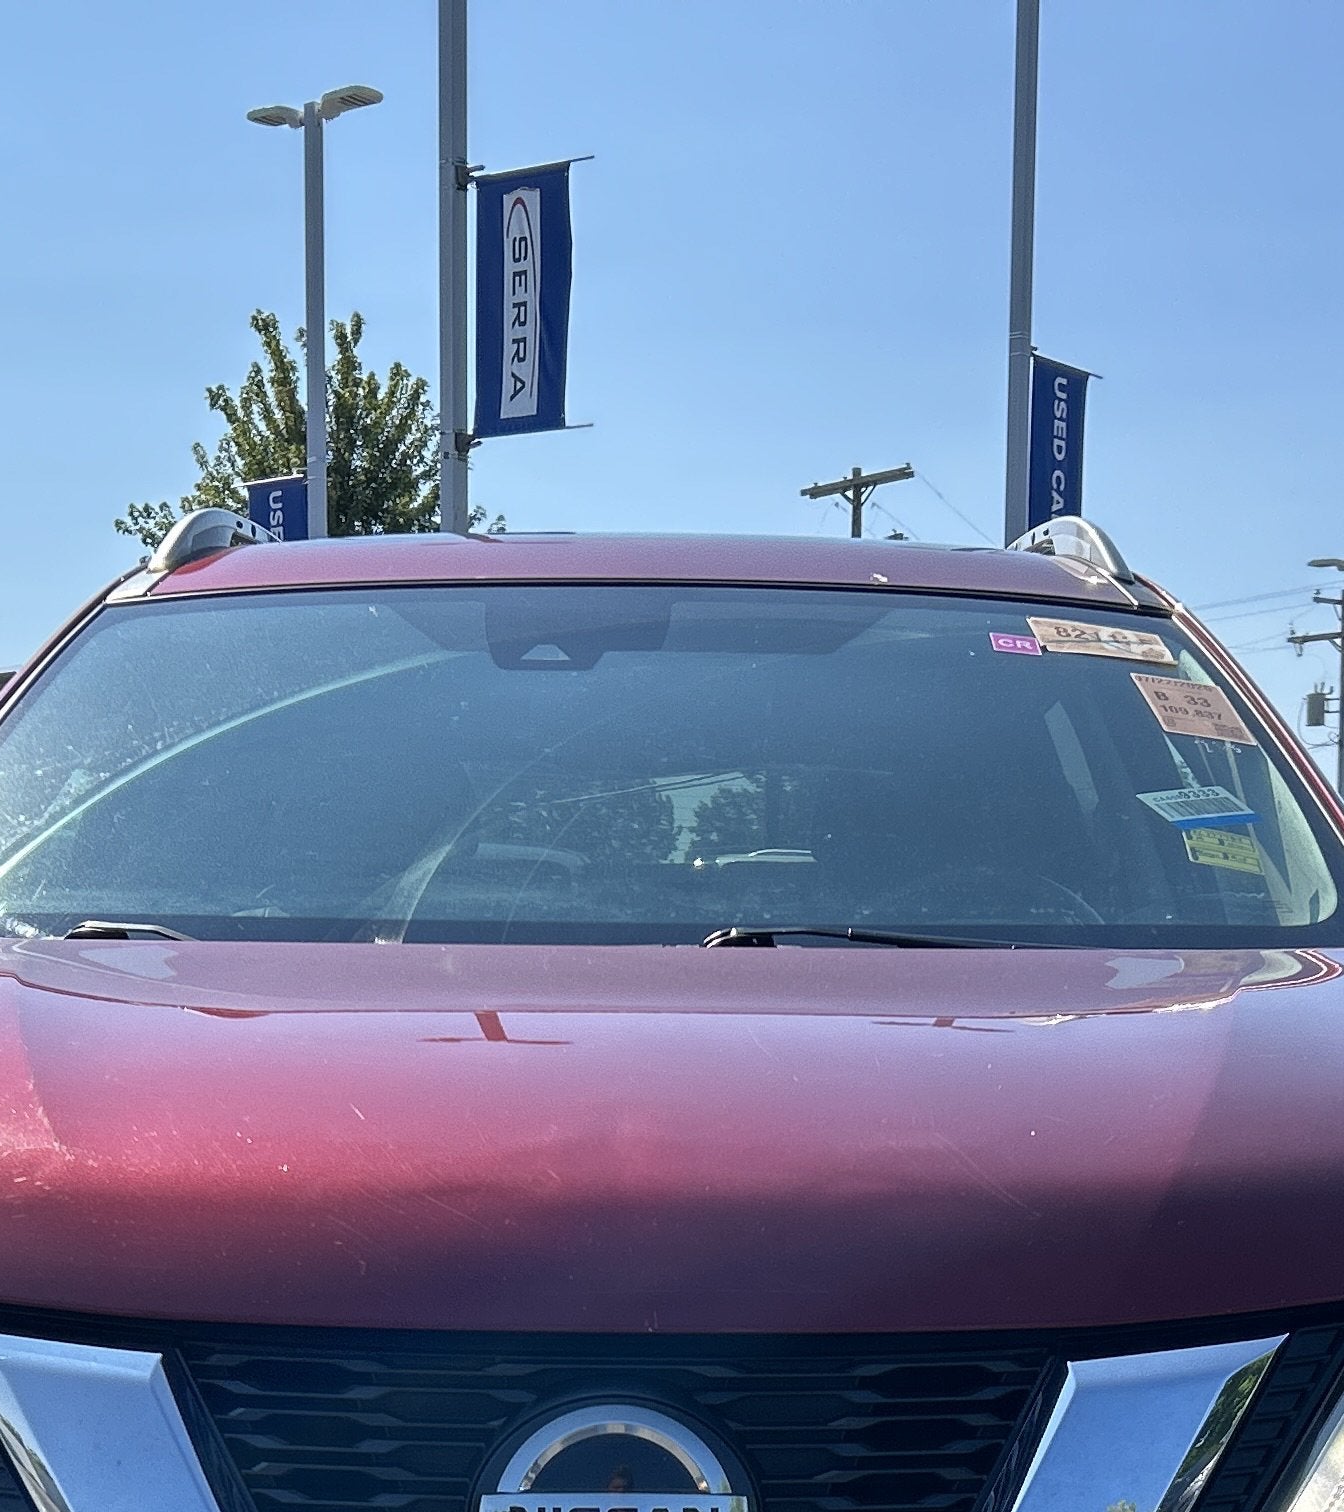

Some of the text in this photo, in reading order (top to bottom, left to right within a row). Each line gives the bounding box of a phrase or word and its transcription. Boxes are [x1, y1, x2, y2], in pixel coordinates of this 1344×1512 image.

[509, 236, 528, 402] SERRA
[1051, 377, 1068, 518] USED CA
[998, 637, 1033, 650] CR
